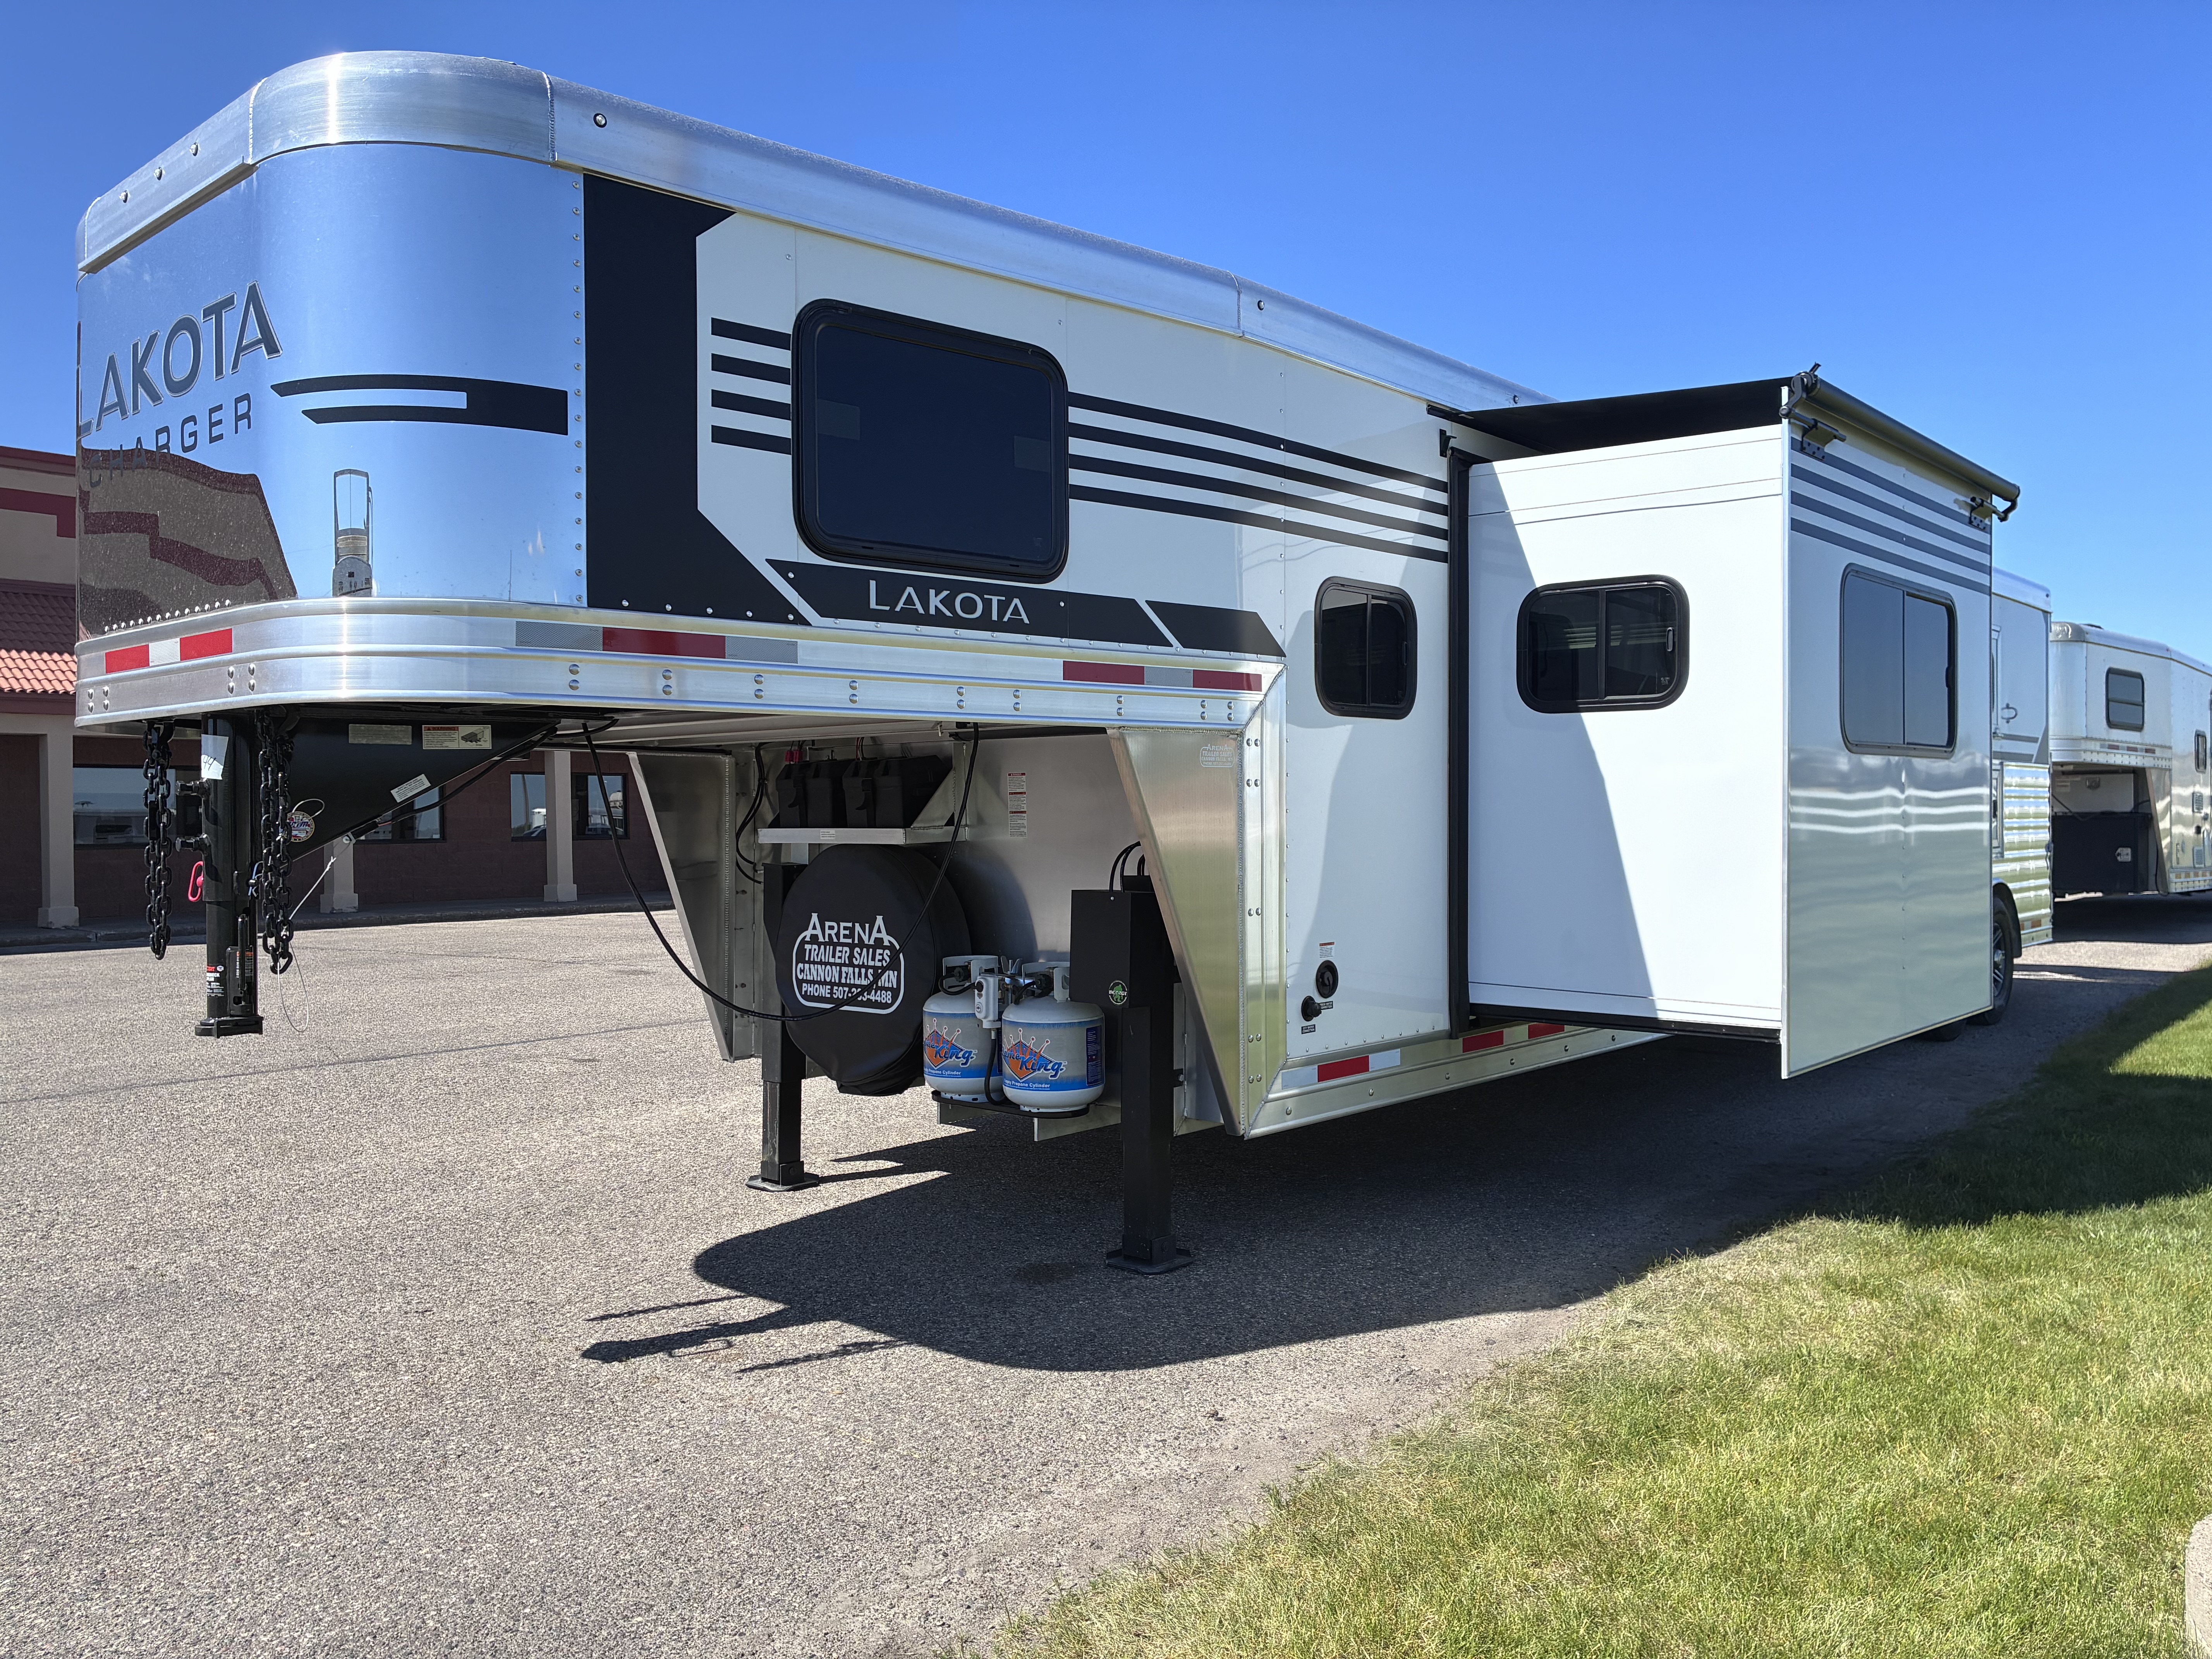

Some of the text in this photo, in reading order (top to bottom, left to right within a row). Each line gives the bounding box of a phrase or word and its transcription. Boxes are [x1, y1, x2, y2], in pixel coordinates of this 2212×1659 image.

[89, 393, 252, 488] CHARGER
[869, 579, 1030, 624] LAKOTA
[804, 913, 891, 946] ARENA
[804, 944, 891, 967] TRAILER SALES
[797, 963, 840, 983] CANNON
[878, 969, 897, 988] MN
[802, 983, 831, 998] PHONE
